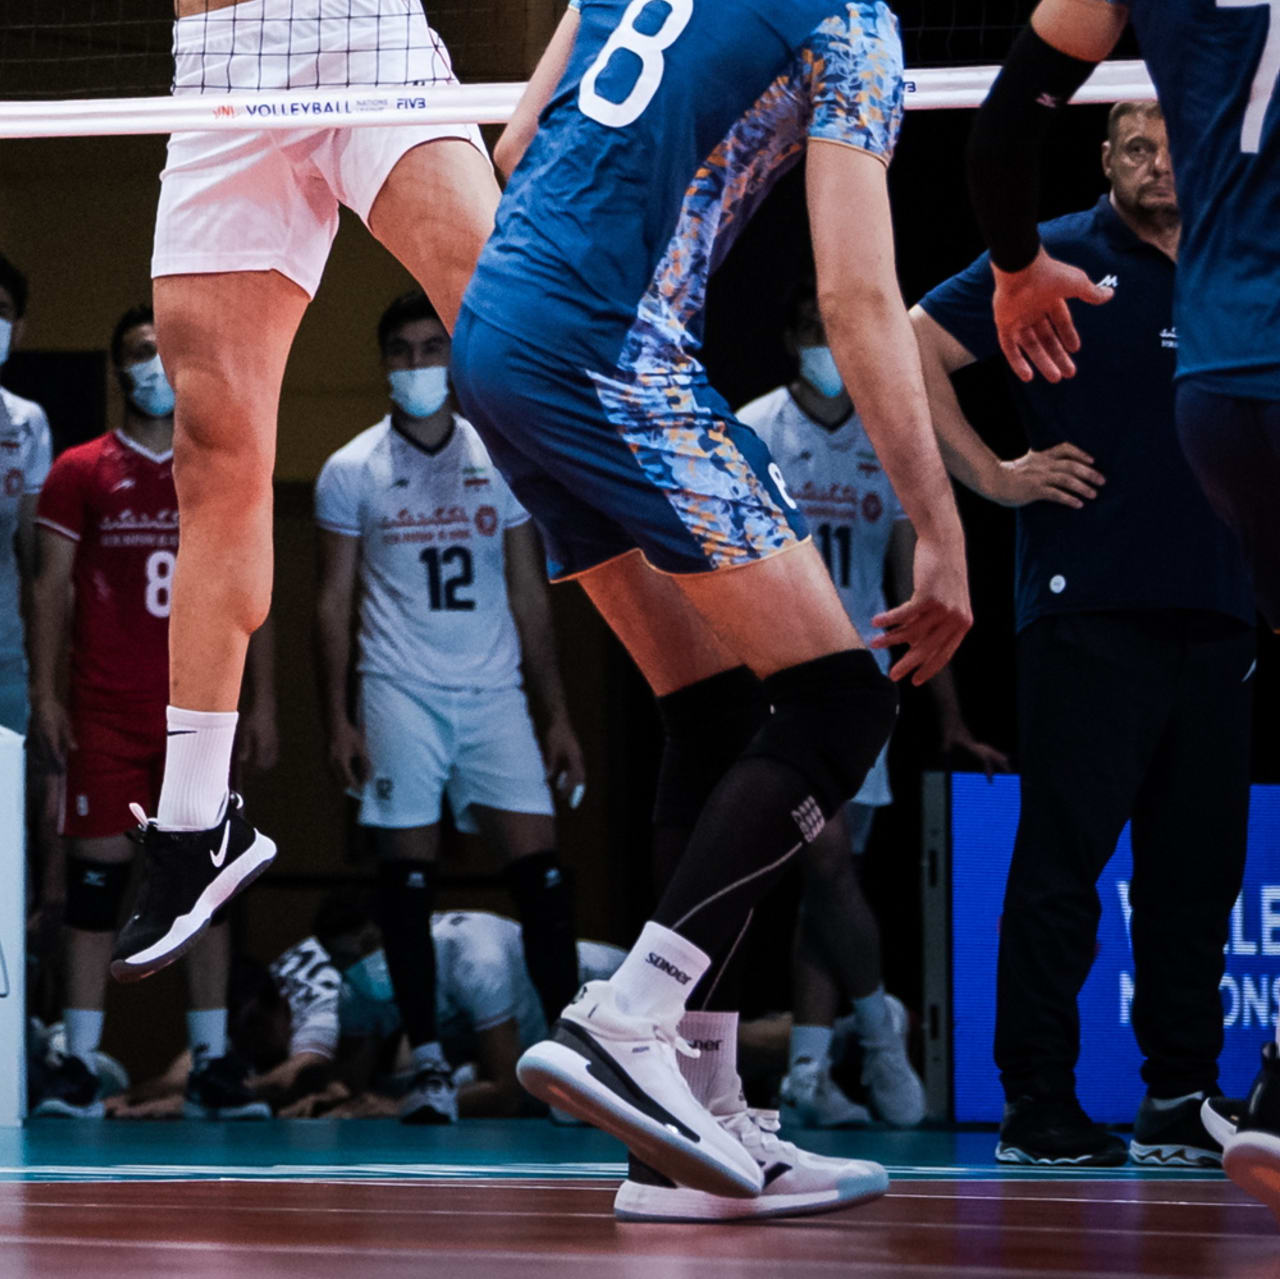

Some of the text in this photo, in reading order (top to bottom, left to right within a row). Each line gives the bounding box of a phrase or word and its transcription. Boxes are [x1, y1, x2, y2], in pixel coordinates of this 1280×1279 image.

[246, 100, 352, 117] VOLLEYBALL
[396, 97, 426, 109] FIVB
[146, 551, 176, 618] 8
[420, 545, 476, 611] 12
[818, 523, 851, 588] 11
